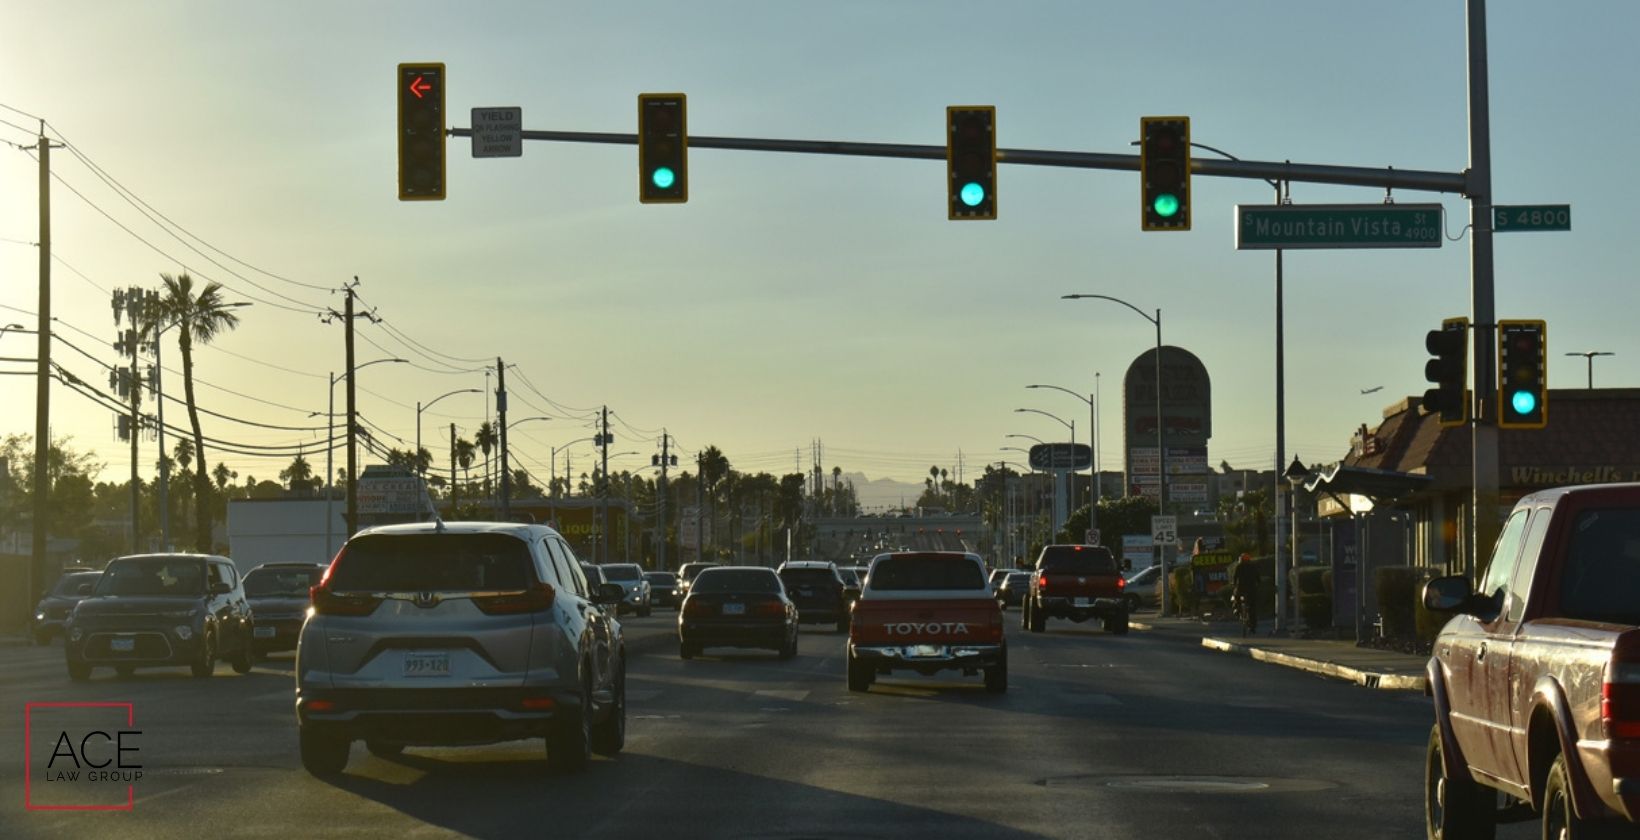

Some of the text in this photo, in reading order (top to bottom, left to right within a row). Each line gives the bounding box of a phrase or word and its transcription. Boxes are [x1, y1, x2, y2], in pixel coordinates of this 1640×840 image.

[481, 111, 513, 121] YIELD
[482, 134, 513, 143] YELLOW
[483, 144, 512, 153] ARROW
[1414, 212, 1427, 225] St
[1496, 210, 1569, 226] S 4800
[1245, 213, 1401, 238] S Mountain Vista
[1405, 226, 1436, 241] 4900
[1511, 465, 1622, 484] Winchell's
[1155, 531, 1175, 543] 45
[883, 622, 969, 635] TOYOTA
